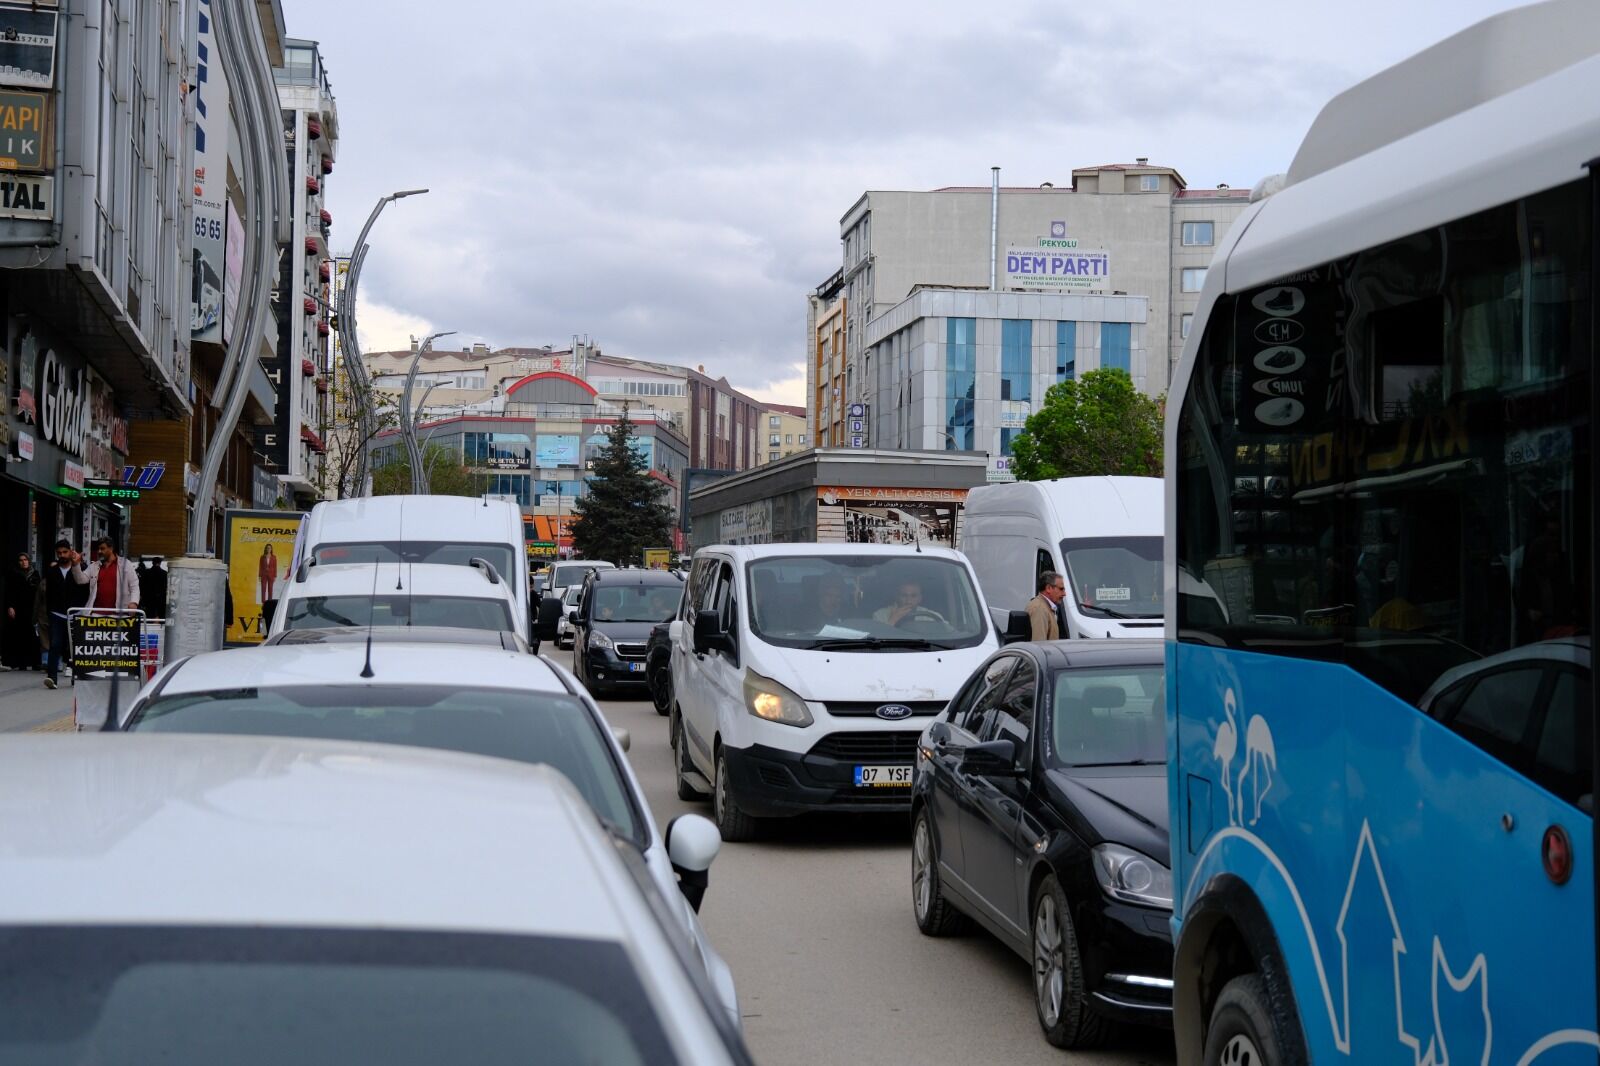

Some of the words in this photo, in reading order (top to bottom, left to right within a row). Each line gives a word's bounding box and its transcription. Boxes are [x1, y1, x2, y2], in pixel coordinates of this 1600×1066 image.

[194, 216, 207, 237] 65
[209, 219, 221, 240] 65
[1039, 238, 1077, 248] İPEKYOLU
[1007, 255, 1047, 274] DEM
[1051, 254, 1108, 275] PARTİ
[111, 489, 140, 498] FOTO
[846, 488, 872, 497] YER
[85, 631, 129, 642] ERKEK
[74, 644, 139, 656] KUAFÖRÜ
[884, 706, 905, 715] Ford
[862, 768, 878, 781] 07
[888, 768, 911, 781] YSF
